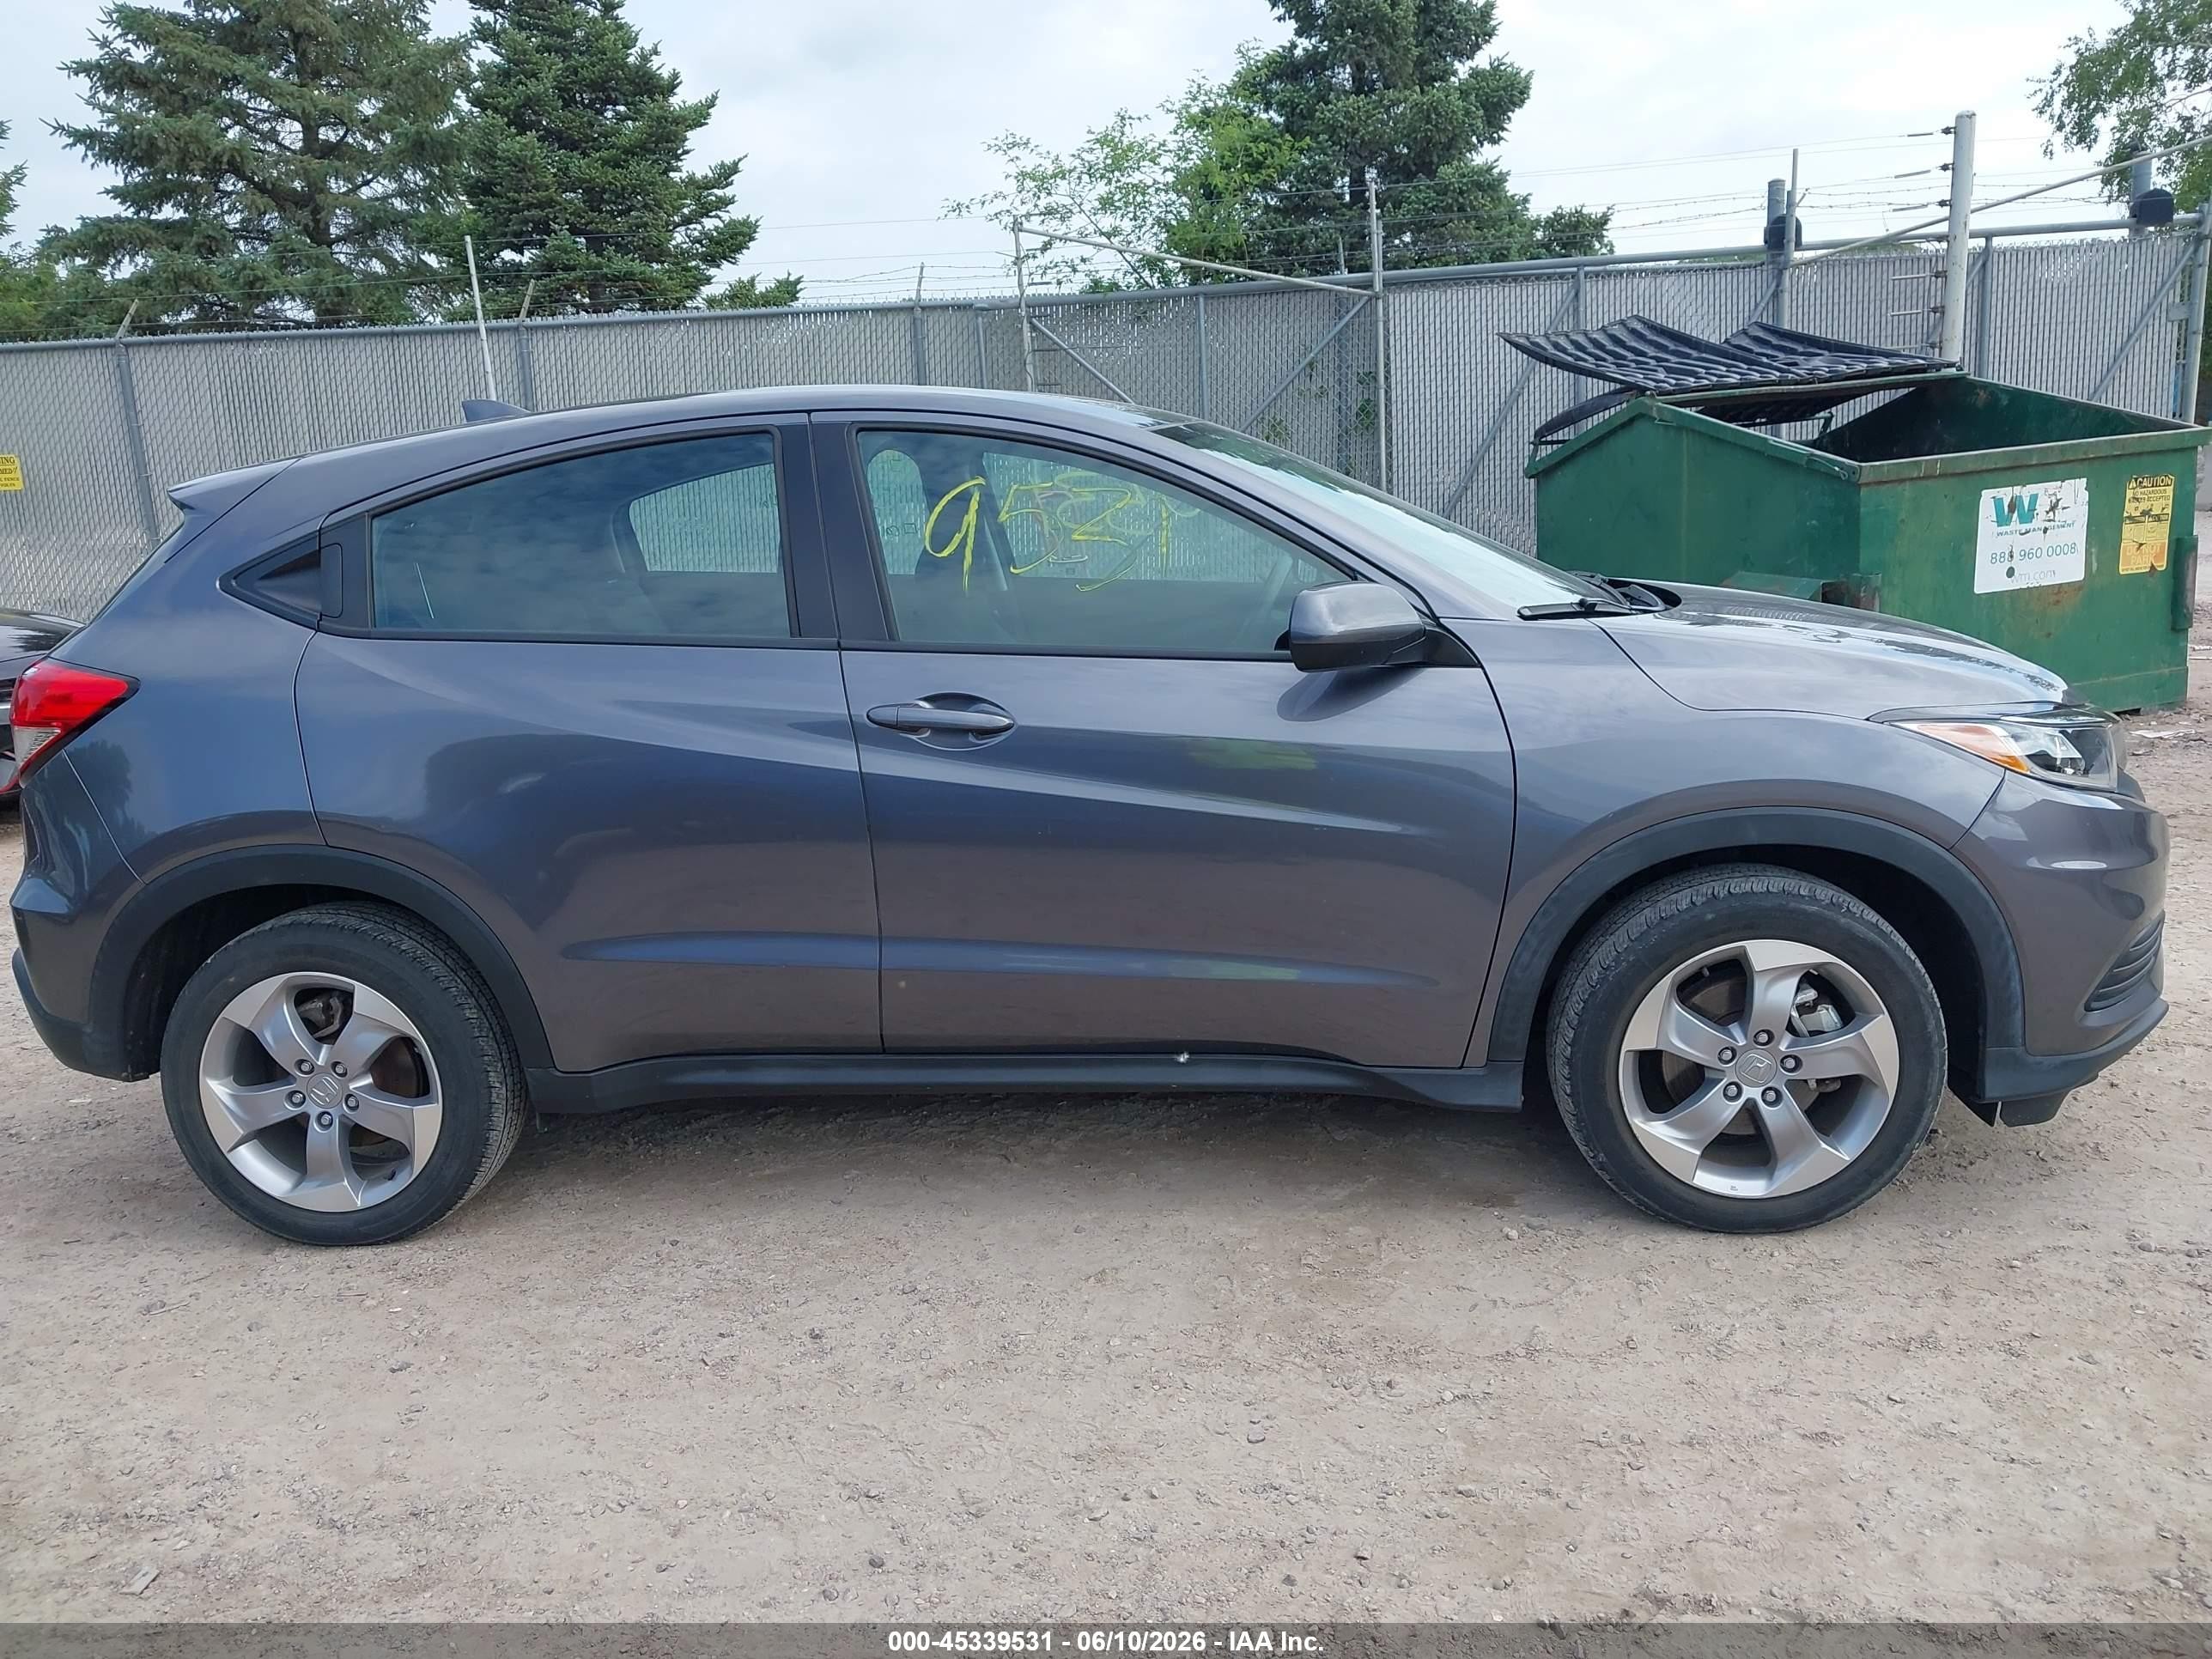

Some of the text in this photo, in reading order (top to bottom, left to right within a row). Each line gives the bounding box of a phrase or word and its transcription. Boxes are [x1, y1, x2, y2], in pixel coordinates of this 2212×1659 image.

[2136, 476, 2172, 488] CAUTION
[2019, 547, 2043, 561] 960
[2046, 542, 2076, 557] 0008
